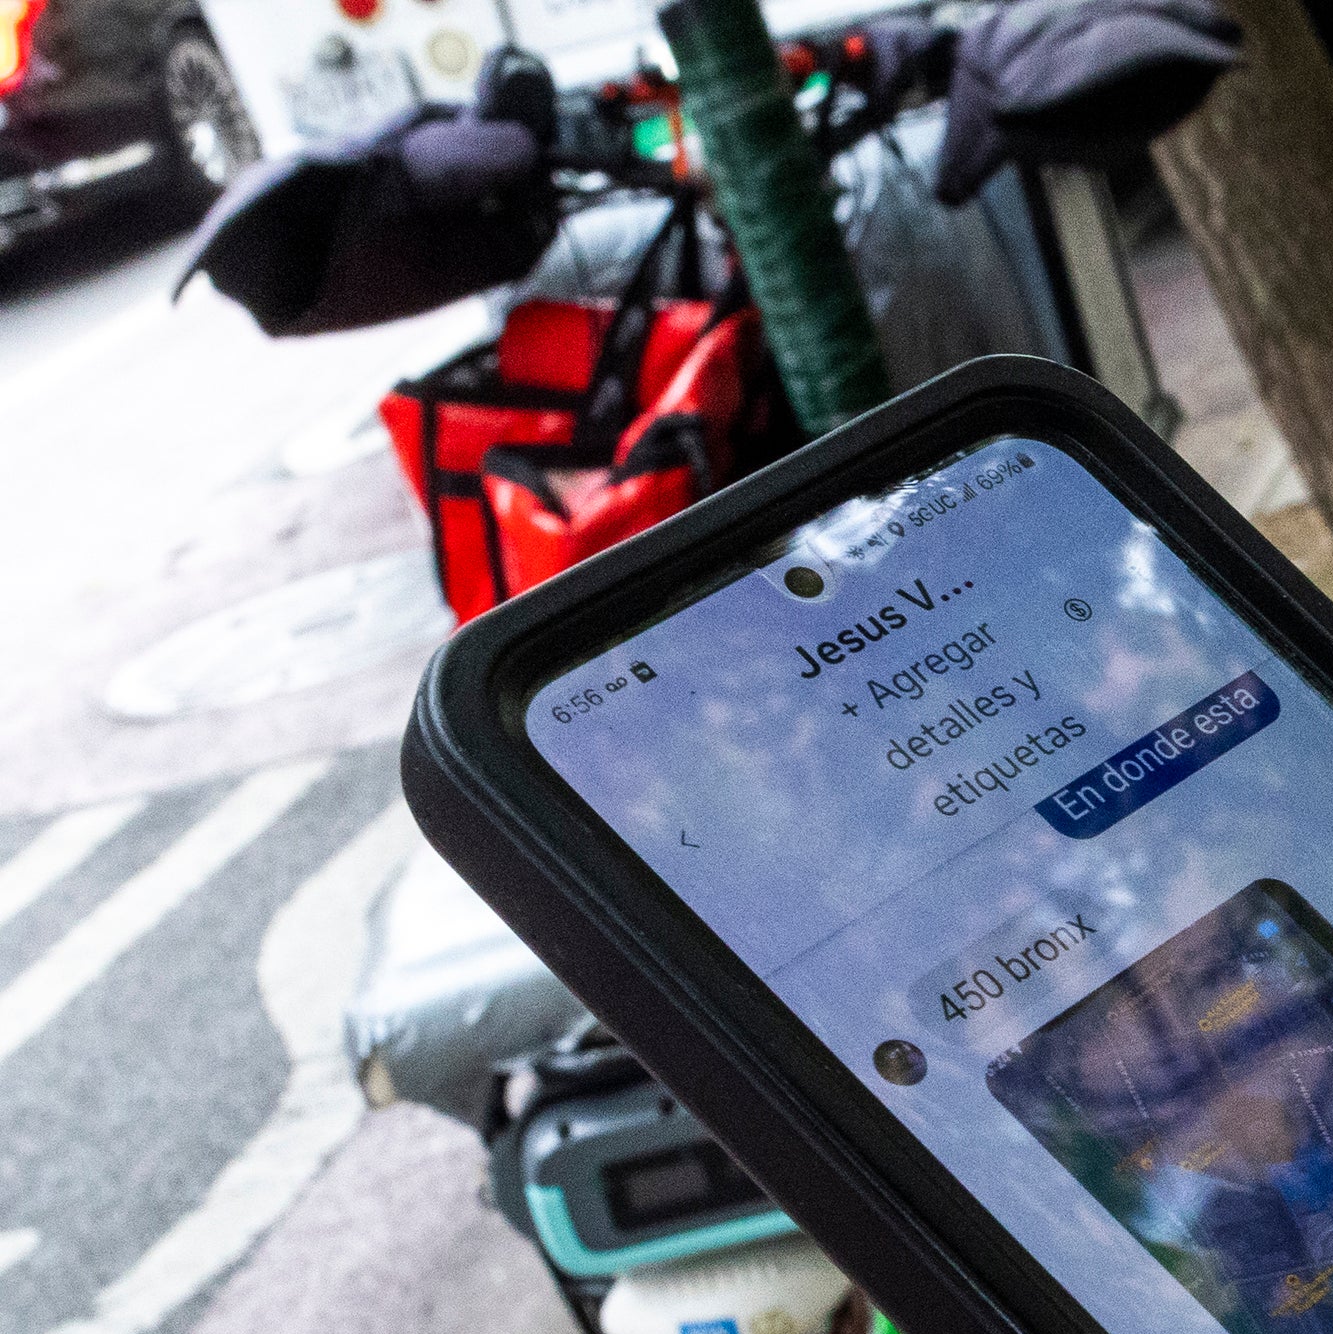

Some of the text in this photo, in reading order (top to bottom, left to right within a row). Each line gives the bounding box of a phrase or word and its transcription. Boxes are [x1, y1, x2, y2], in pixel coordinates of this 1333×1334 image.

[976, 460, 1022, 490] 69%
[795, 605, 908, 679] Jesus
[867, 622, 997, 709] Agregar
[552, 688, 603, 725] 6:56
[886, 669, 1041, 771] detalles y
[934, 714, 1086, 817] etiquetas
[1055, 687, 1260, 821] En donde esta
[939, 914, 1098, 1024] 450 bronx
